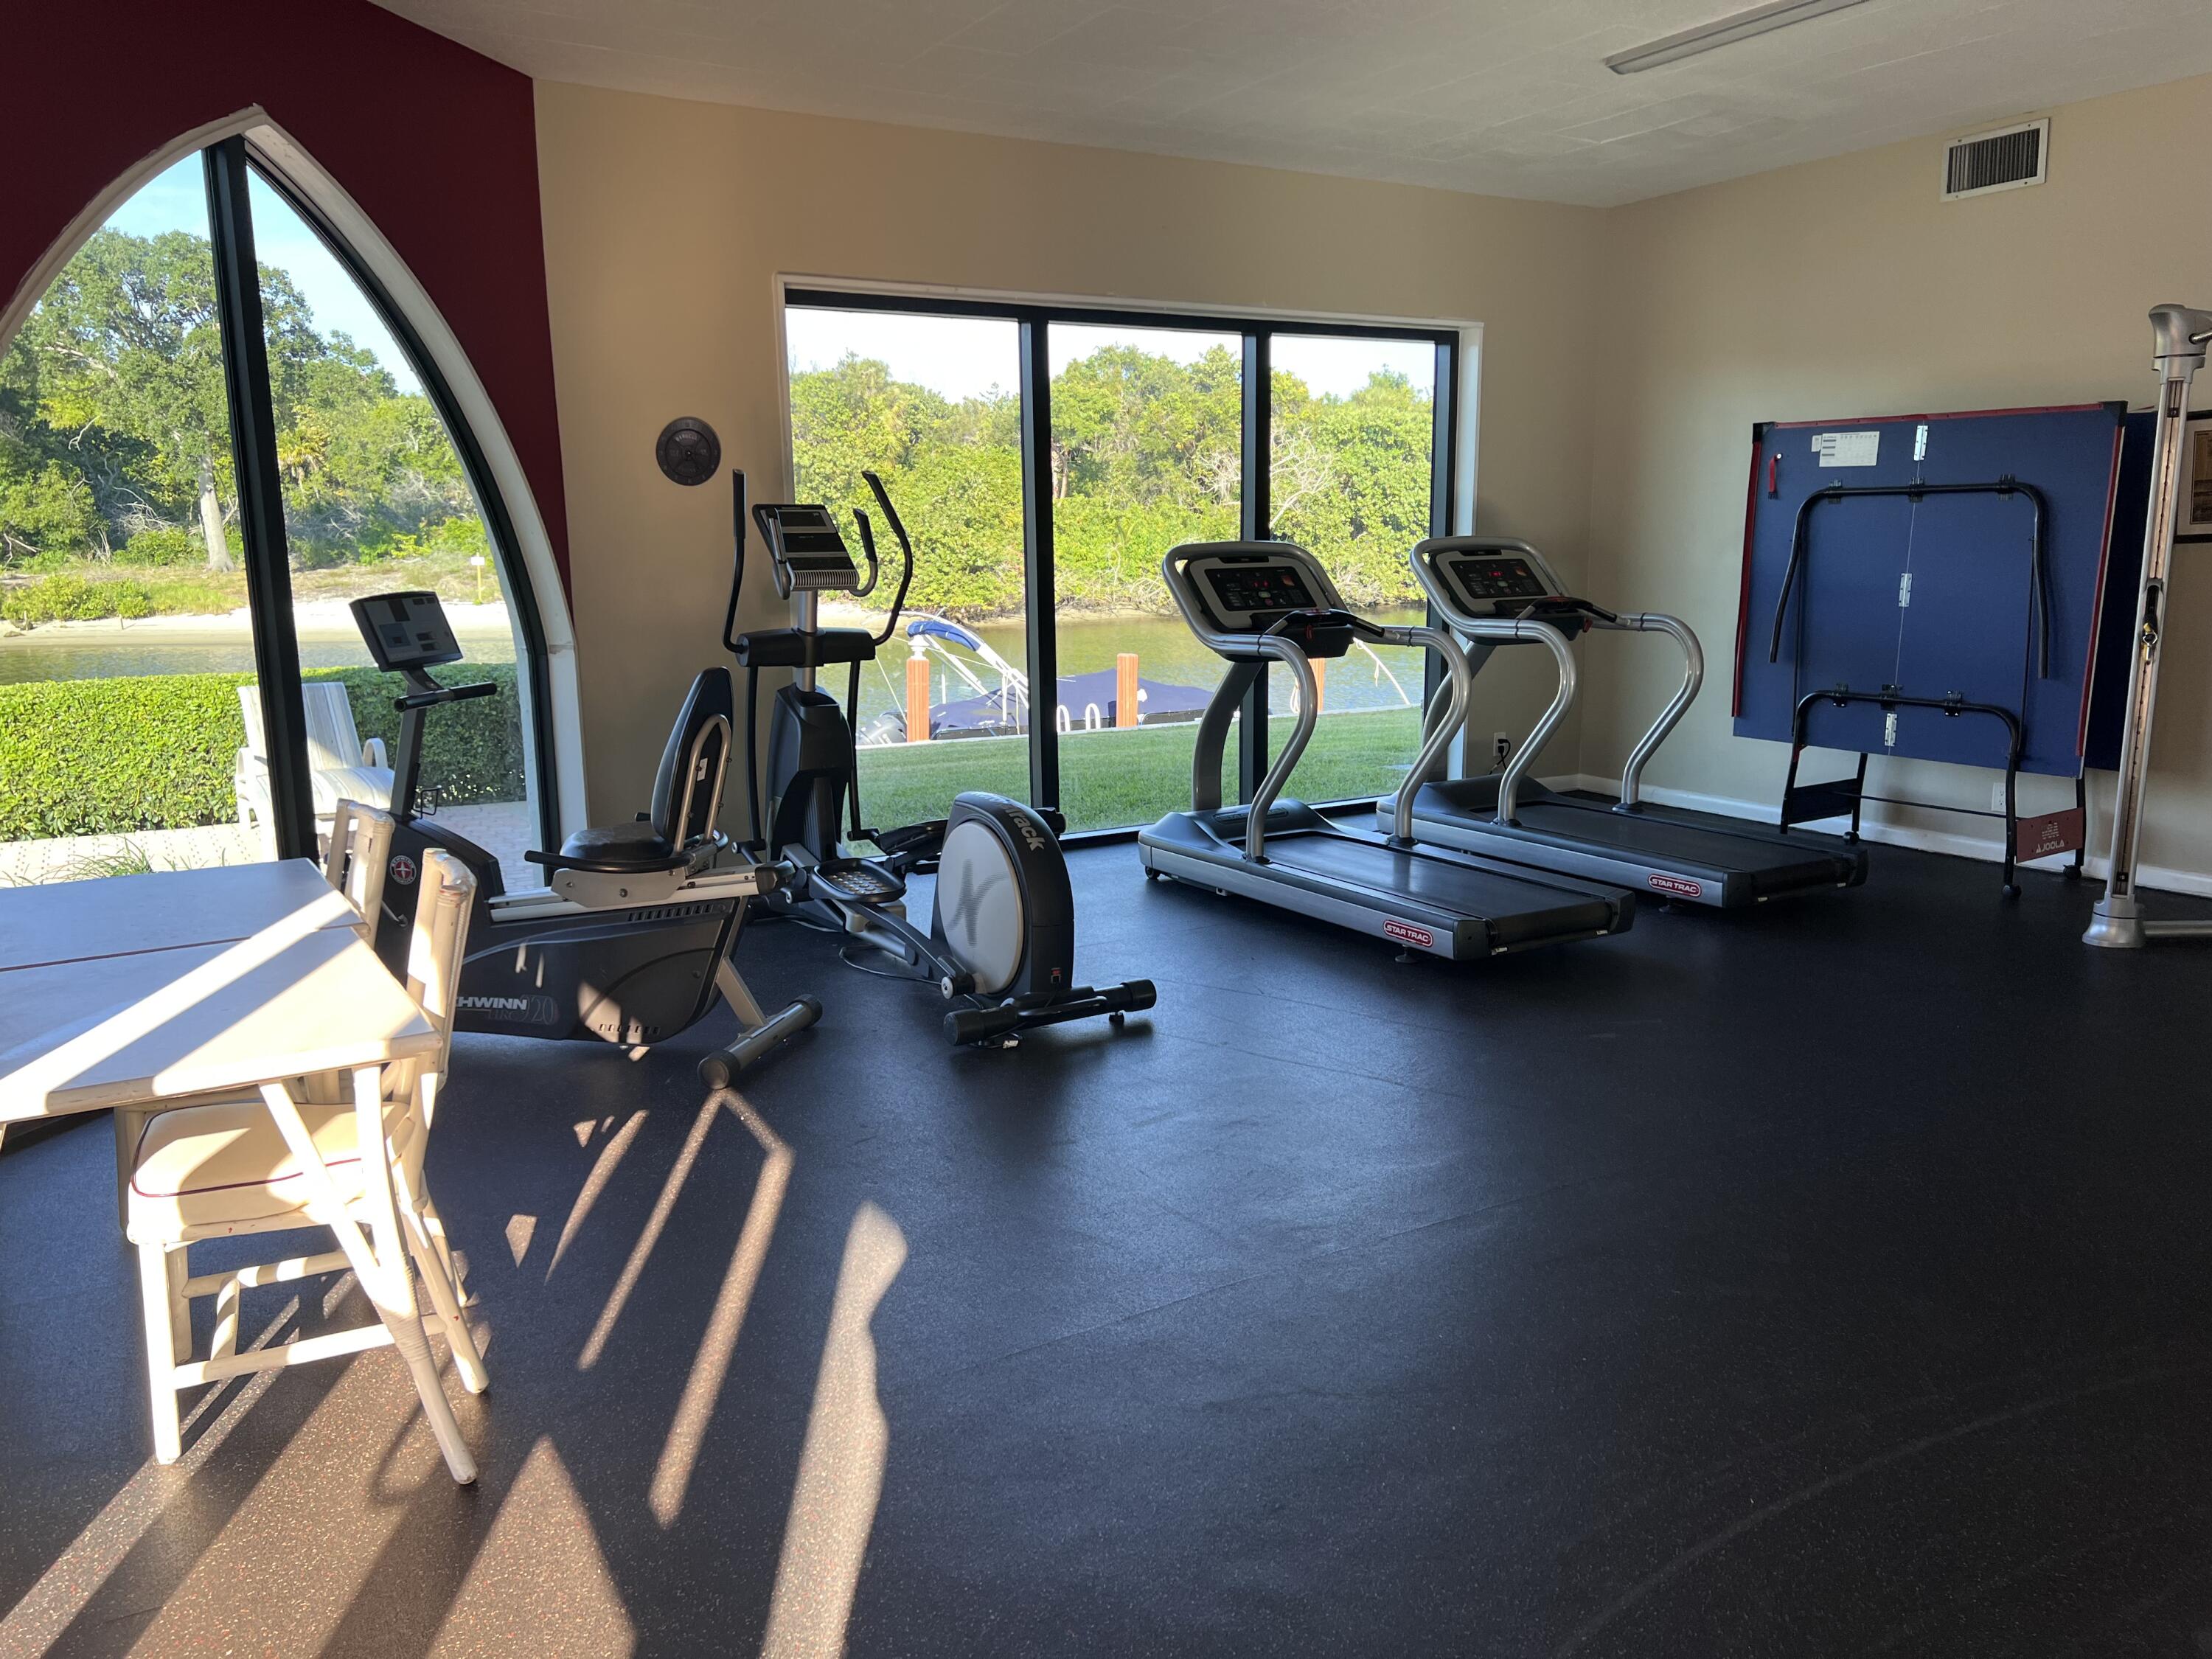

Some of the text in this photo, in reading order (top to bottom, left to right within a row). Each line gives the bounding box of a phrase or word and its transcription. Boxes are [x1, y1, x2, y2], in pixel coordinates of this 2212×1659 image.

[2041, 836, 2065, 852] JOOLA
[1652, 878, 1697, 893] STAR TRAC
[1385, 925, 1429, 942] STAR TRAC
[456, 996, 528, 1010] HWINN
